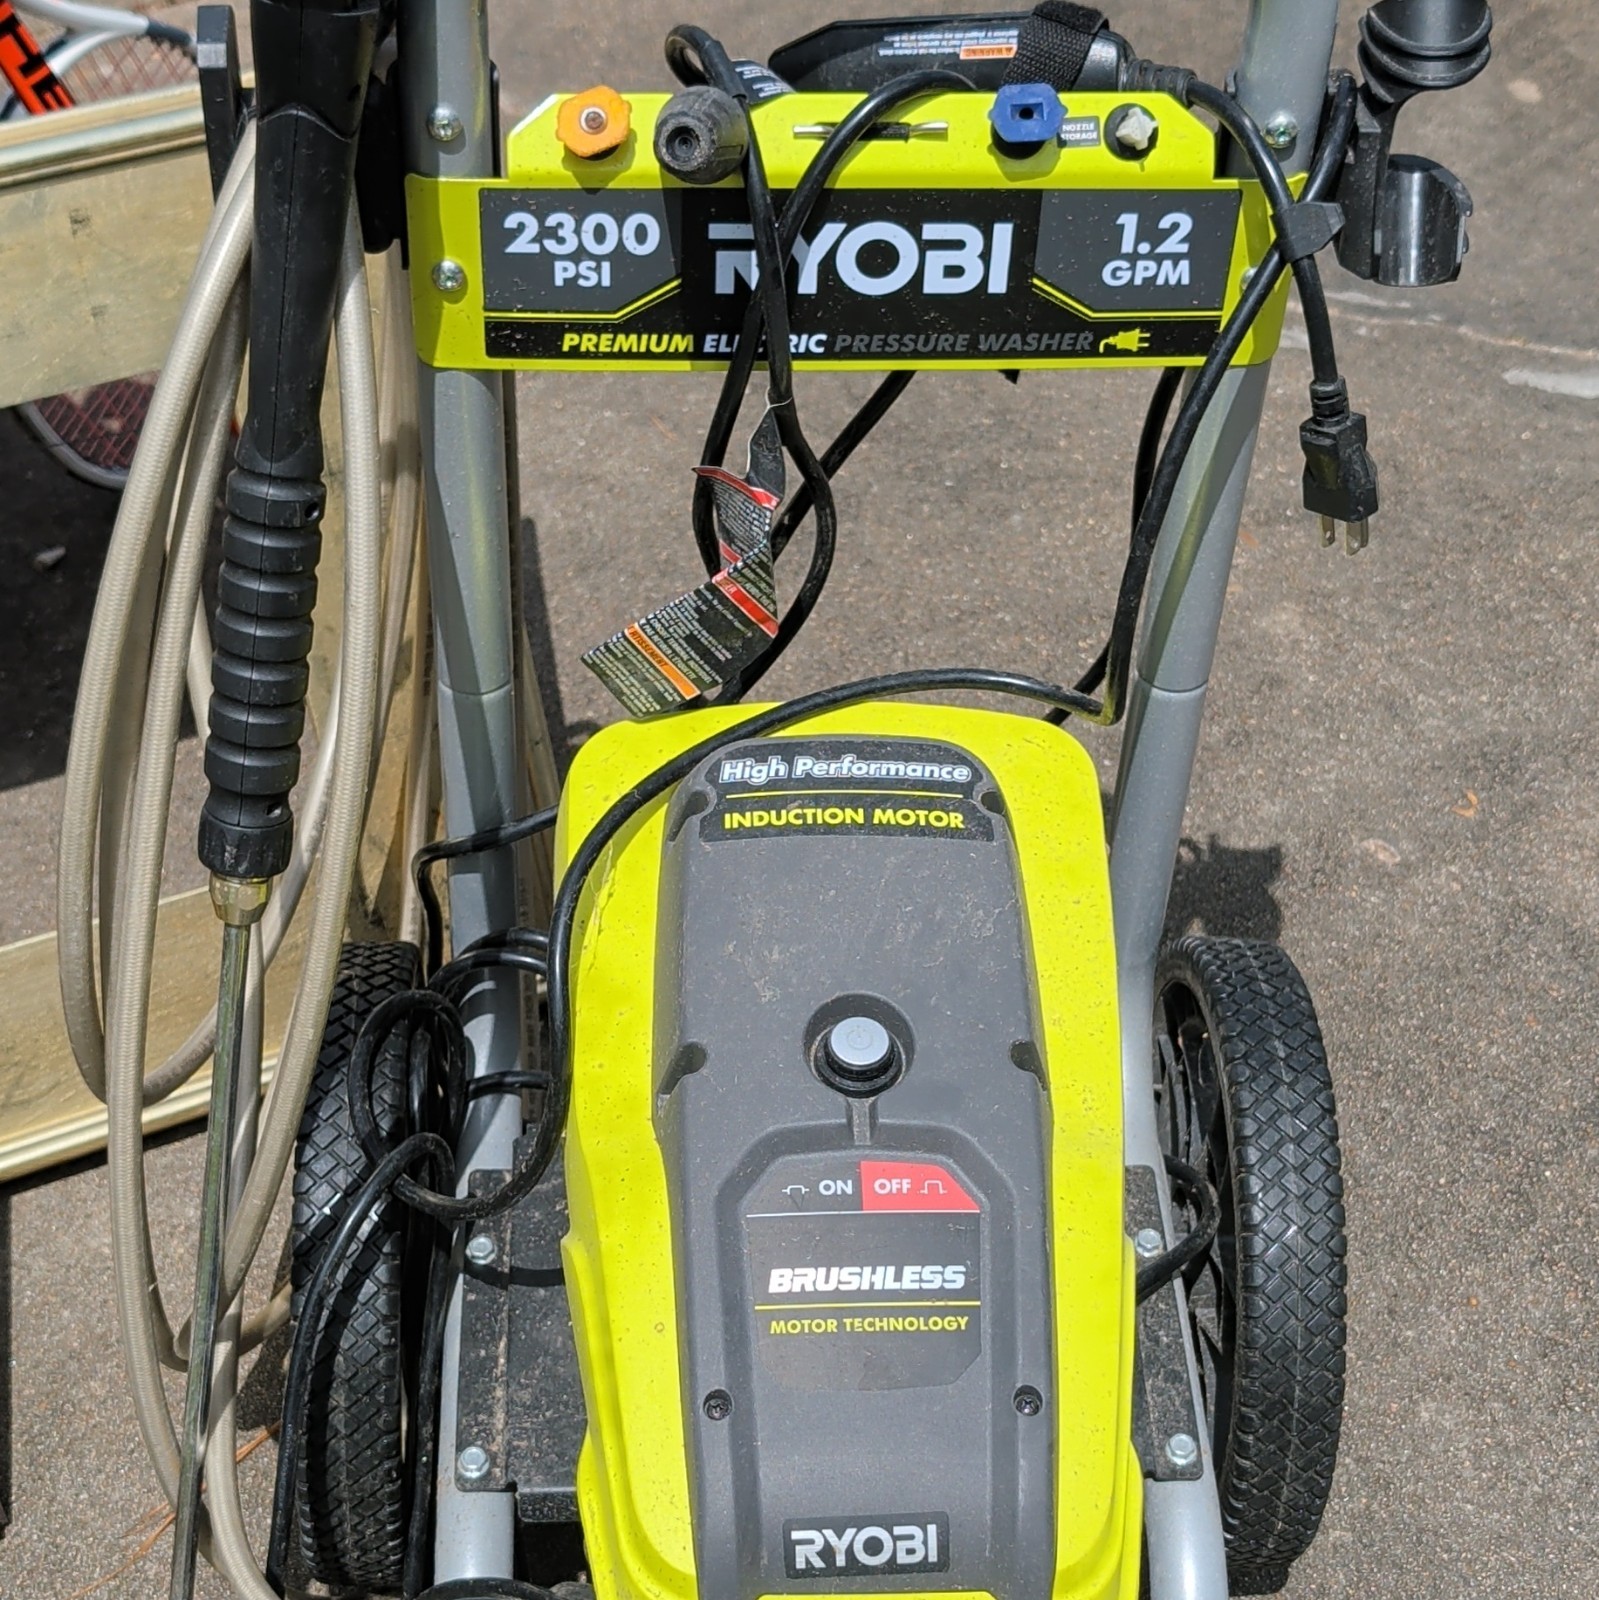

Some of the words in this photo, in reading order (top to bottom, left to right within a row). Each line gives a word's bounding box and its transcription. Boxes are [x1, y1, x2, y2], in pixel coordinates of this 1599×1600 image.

[1061, 132, 1098, 141] STORAGE
[1062, 122, 1095, 132] NOZZLE
[503, 211, 661, 256] 2300
[1116, 212, 1193, 255] 1.2
[708, 220, 1013, 296] RYOBI
[553, 261, 611, 288] PSI
[1101, 259, 1190, 287] GPM
[562, 334, 694, 353] PREMIUM
[703, 334, 828, 354] ELRIC
[834, 334, 969, 353] PRESSURE
[979, 332, 1094, 352] WASHER
[720, 756, 787, 784] High
[792, 755, 972, 782] Performance
[724, 808, 864, 829] INDUCTION
[873, 808, 965, 829] MOTOR
[818, 1180, 852, 1195] ON
[874, 1179, 911, 1194] OFF
[768, 1265, 966, 1293] BRUSHLESS
[770, 1318, 838, 1334] MOTOR
[843, 1316, 969, 1332] TECHNOLOGY
[791, 1524, 938, 1569] RYOBI
